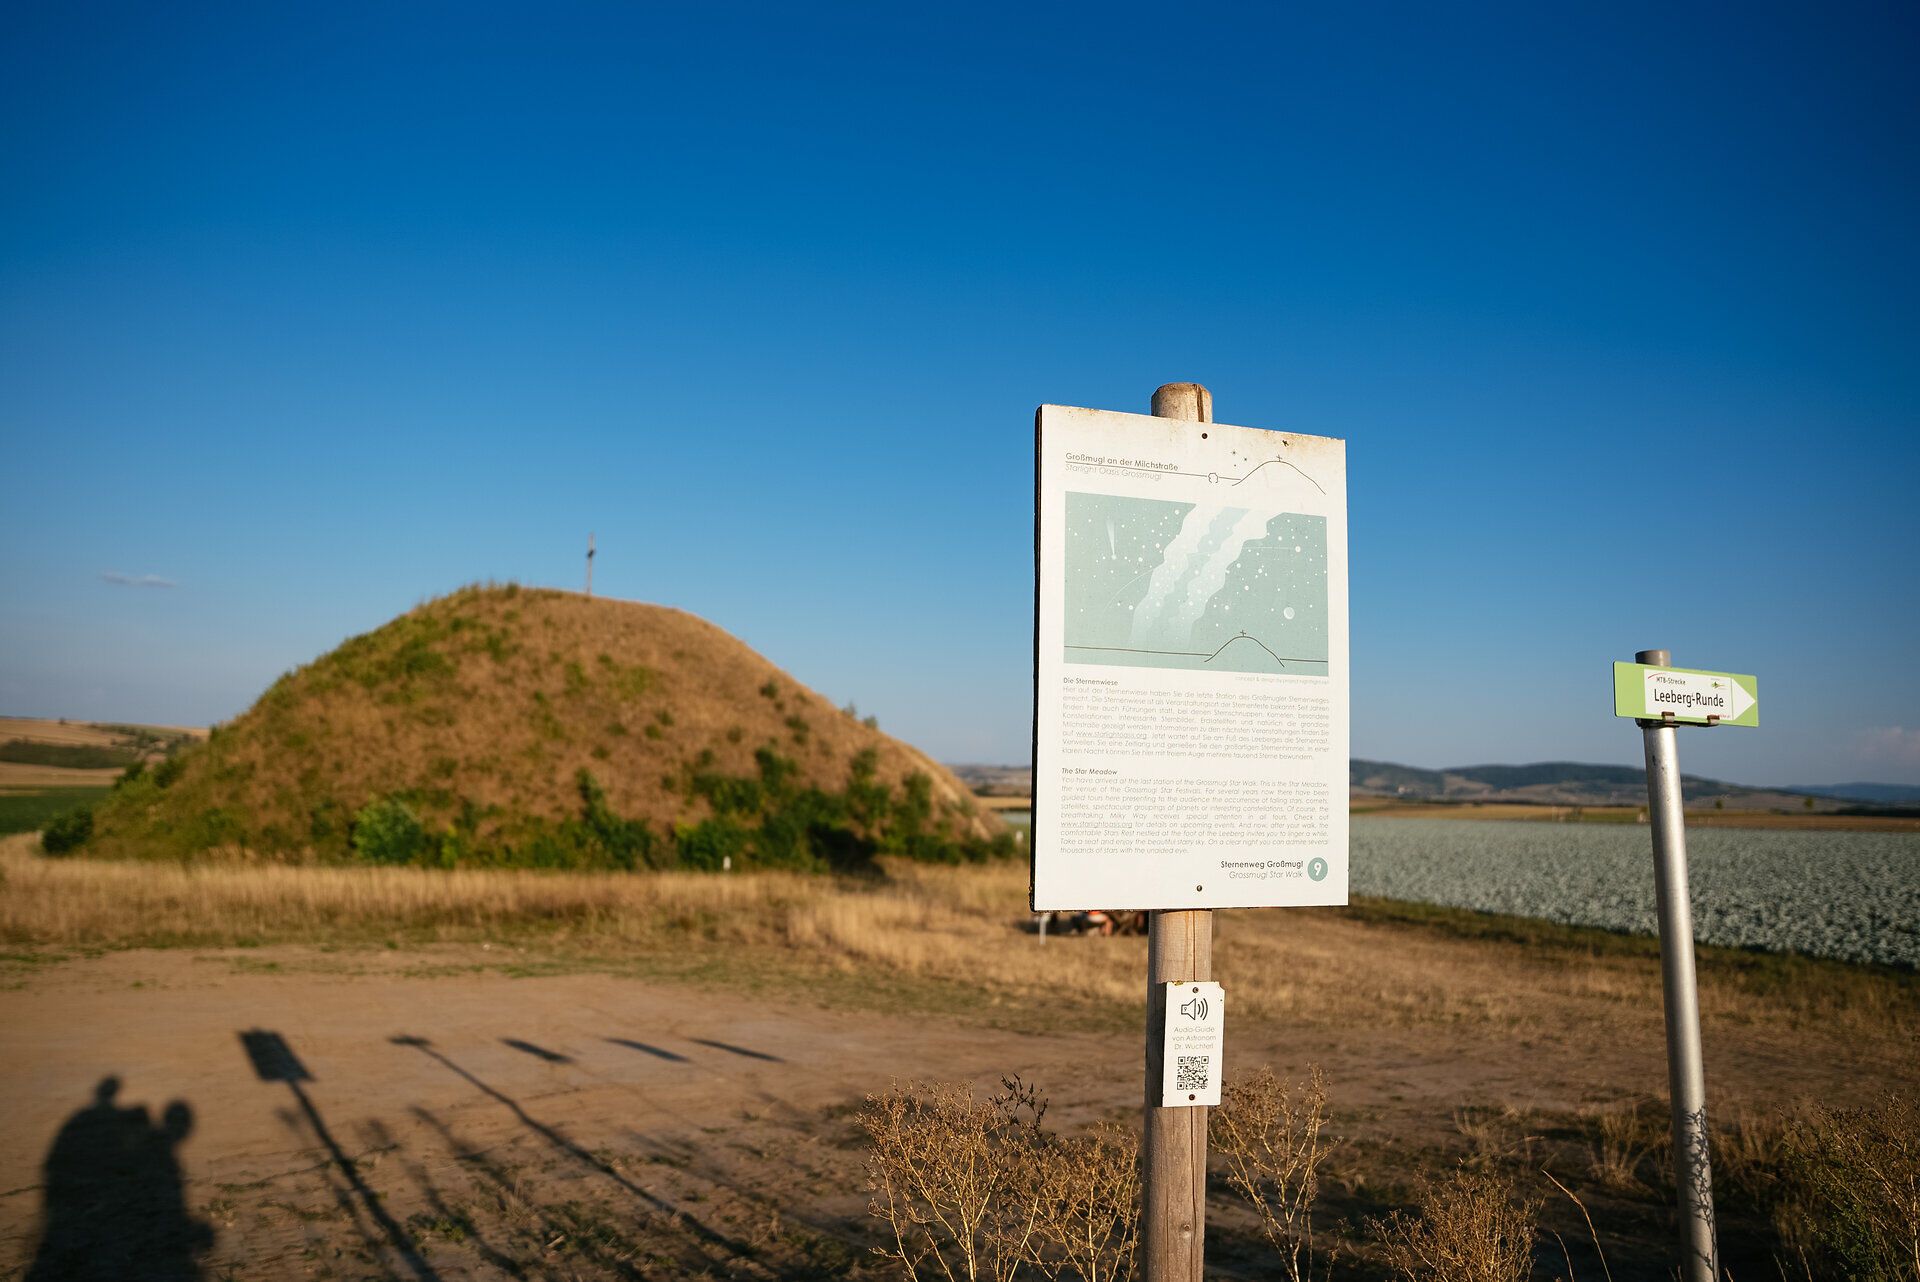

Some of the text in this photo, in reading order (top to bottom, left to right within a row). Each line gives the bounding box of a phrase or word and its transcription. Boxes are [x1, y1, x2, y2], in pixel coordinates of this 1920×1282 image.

[1065, 452, 1105, 464] Großmugl
[1135, 460, 1179, 471] Milchstraße
[1065, 464, 1161, 481] Starlight Oasis Grossmugl
[1076, 677, 1119, 686] Sternenwiese
[1656, 676, 1686, 686] MTB-Strecke
[1654, 688, 1724, 708] Leeberg-Runde
[1220, 860, 1304, 869] Sternenweg Großmugl
[1314, 862, 1322, 876] 9
[1229, 871, 1268, 880] Grossmugl
